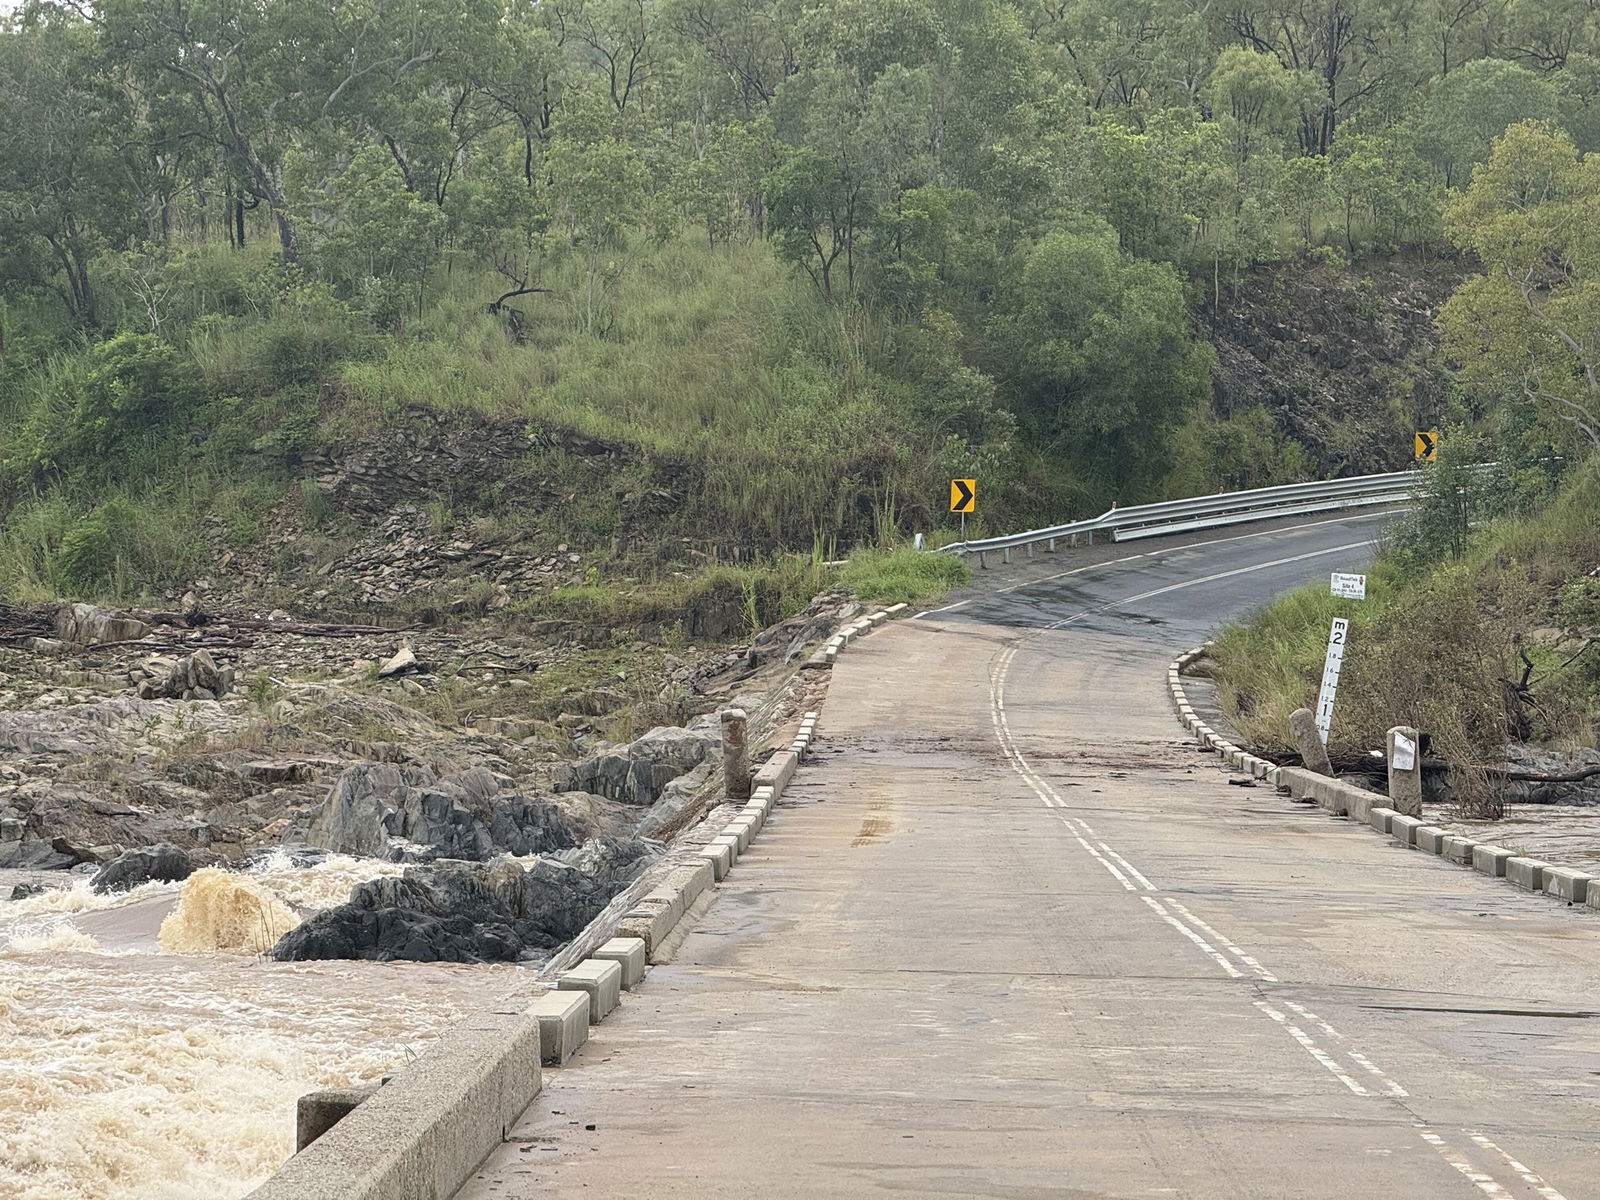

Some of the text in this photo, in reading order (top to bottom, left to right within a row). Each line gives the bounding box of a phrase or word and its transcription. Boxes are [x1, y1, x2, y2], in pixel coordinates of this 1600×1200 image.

[1334, 622, 1345, 630] m
[1332, 632, 1342, 644] 2
[1323, 704, 1327, 716] 1
